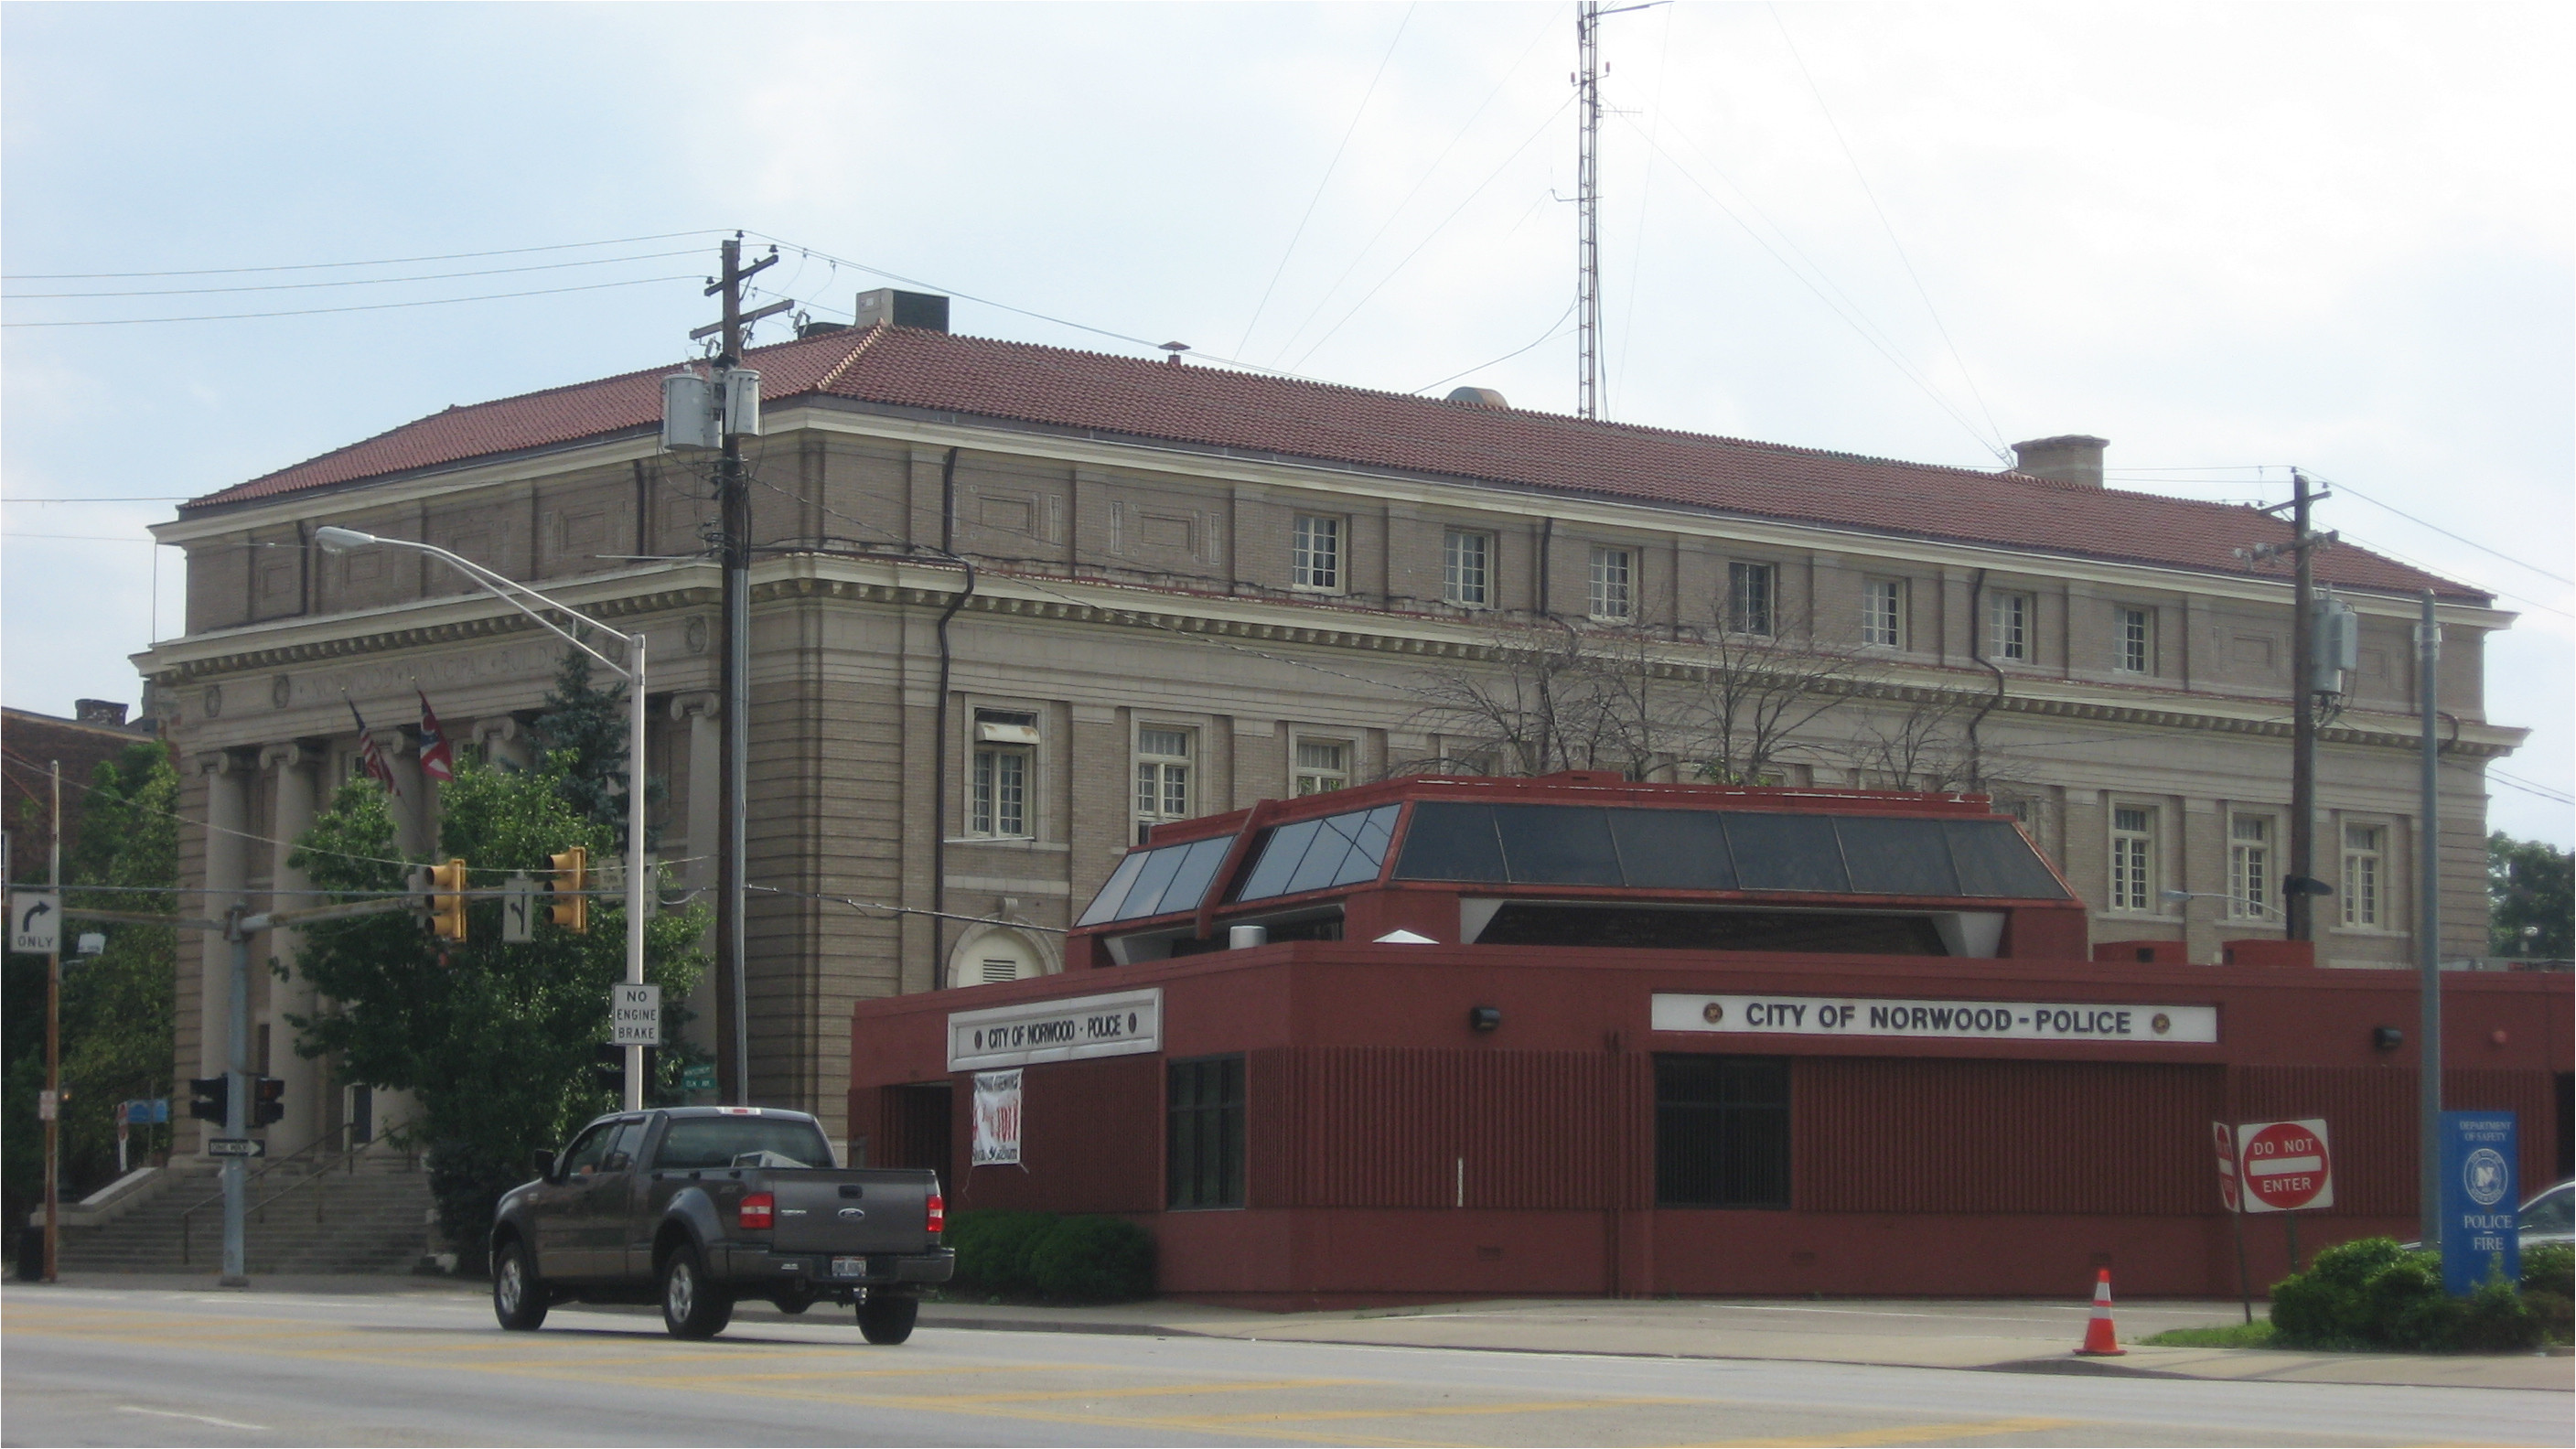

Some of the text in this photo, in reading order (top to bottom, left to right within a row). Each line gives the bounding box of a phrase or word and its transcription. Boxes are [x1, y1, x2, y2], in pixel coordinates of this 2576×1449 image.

[17, 936, 53, 948] ONLY
[627, 991, 647, 1003] NO
[617, 1009, 657, 1021] ENGINE
[1745, 1003, 1807, 1027] CITY
[1819, 1004, 1856, 1029] OF
[618, 1026, 655, 1039] BRAKE
[988, 1026, 1009, 1049] CITY
[1012, 1025, 1025, 1047] OF
[1027, 1019, 1075, 1046] NORWOOD
[1087, 1014, 1122, 1039] POLICE
[2459, 1121, 2512, 1131] DEPARTMENT
[2464, 1132, 2507, 1142] OF SAFETY
[2253, 1138, 2314, 1155] DO NOT
[2263, 1177, 2313, 1193] ENTER
[2463, 1215, 2513, 1229] POLICE
[2474, 1237, 2505, 1250] FIRE
